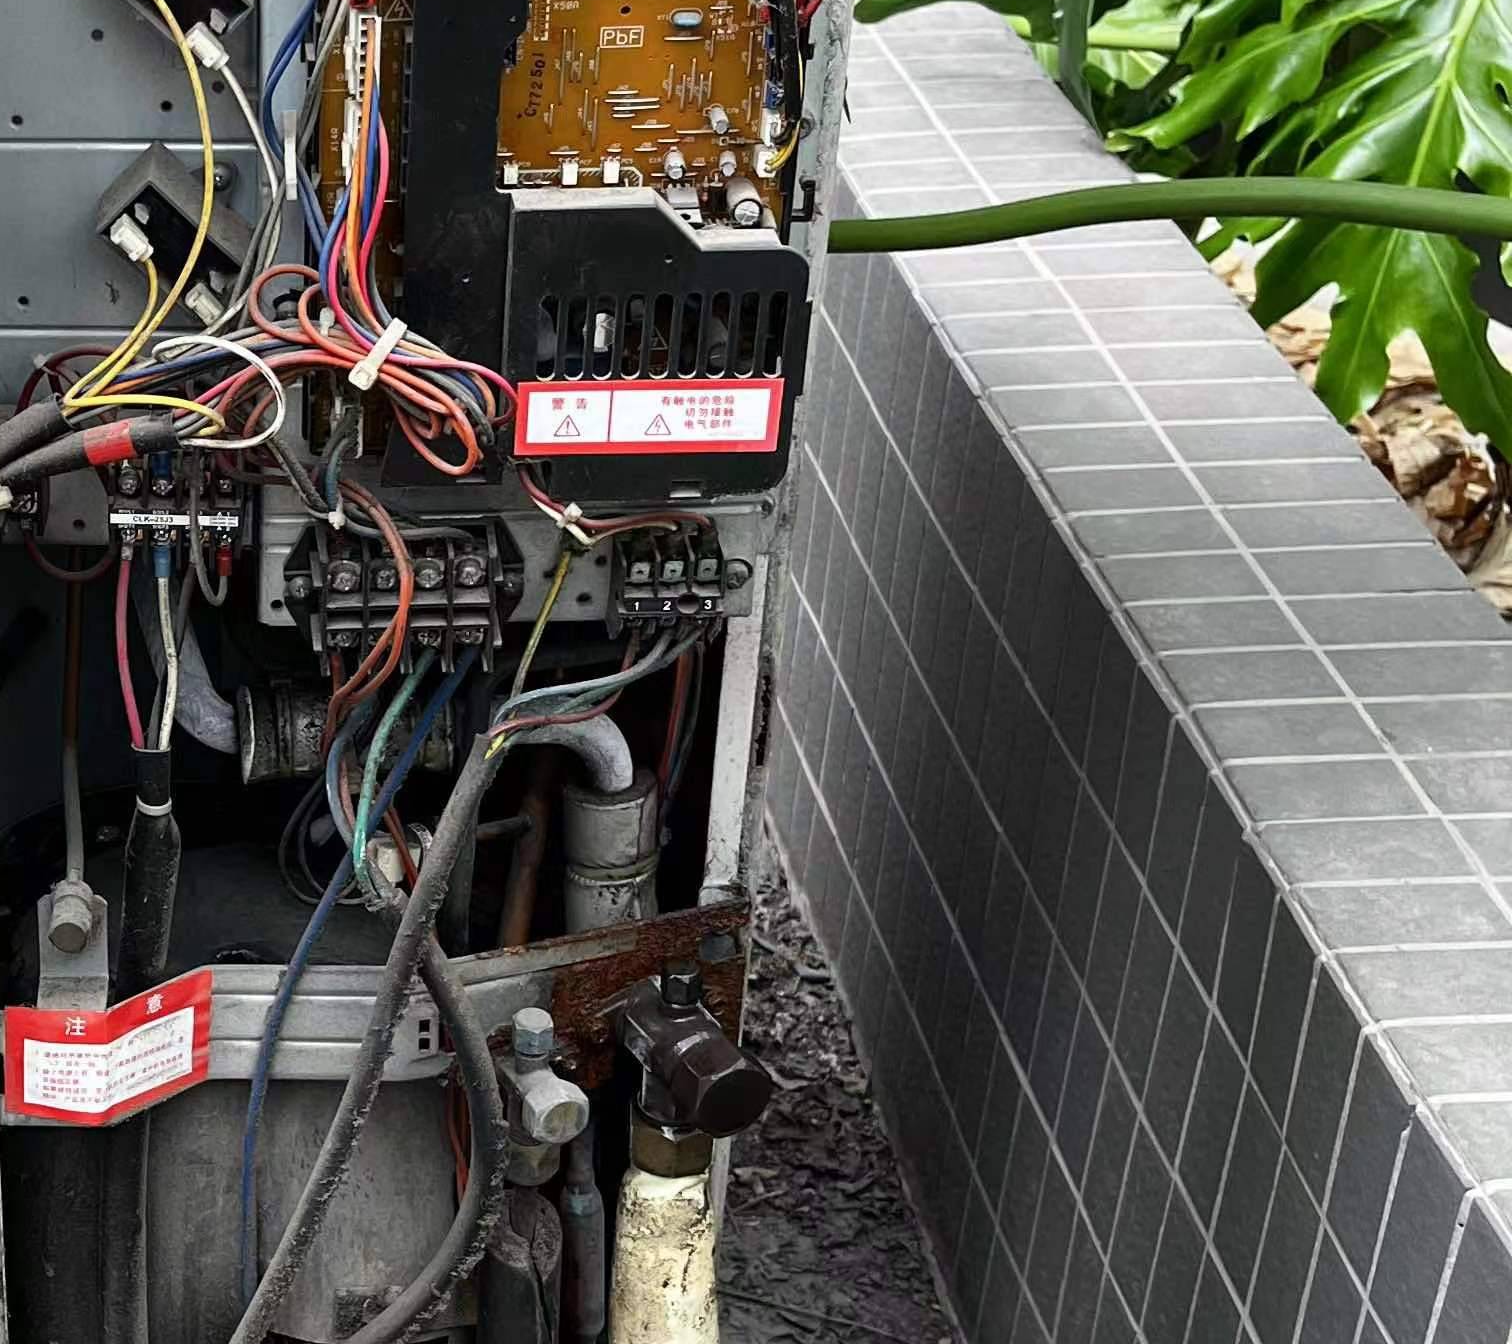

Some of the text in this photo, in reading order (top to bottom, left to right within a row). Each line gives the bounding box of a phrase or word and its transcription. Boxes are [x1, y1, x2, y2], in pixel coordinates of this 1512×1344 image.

[603, 29, 641, 46] PbF
[634, 599, 713, 612] 1 2 3
